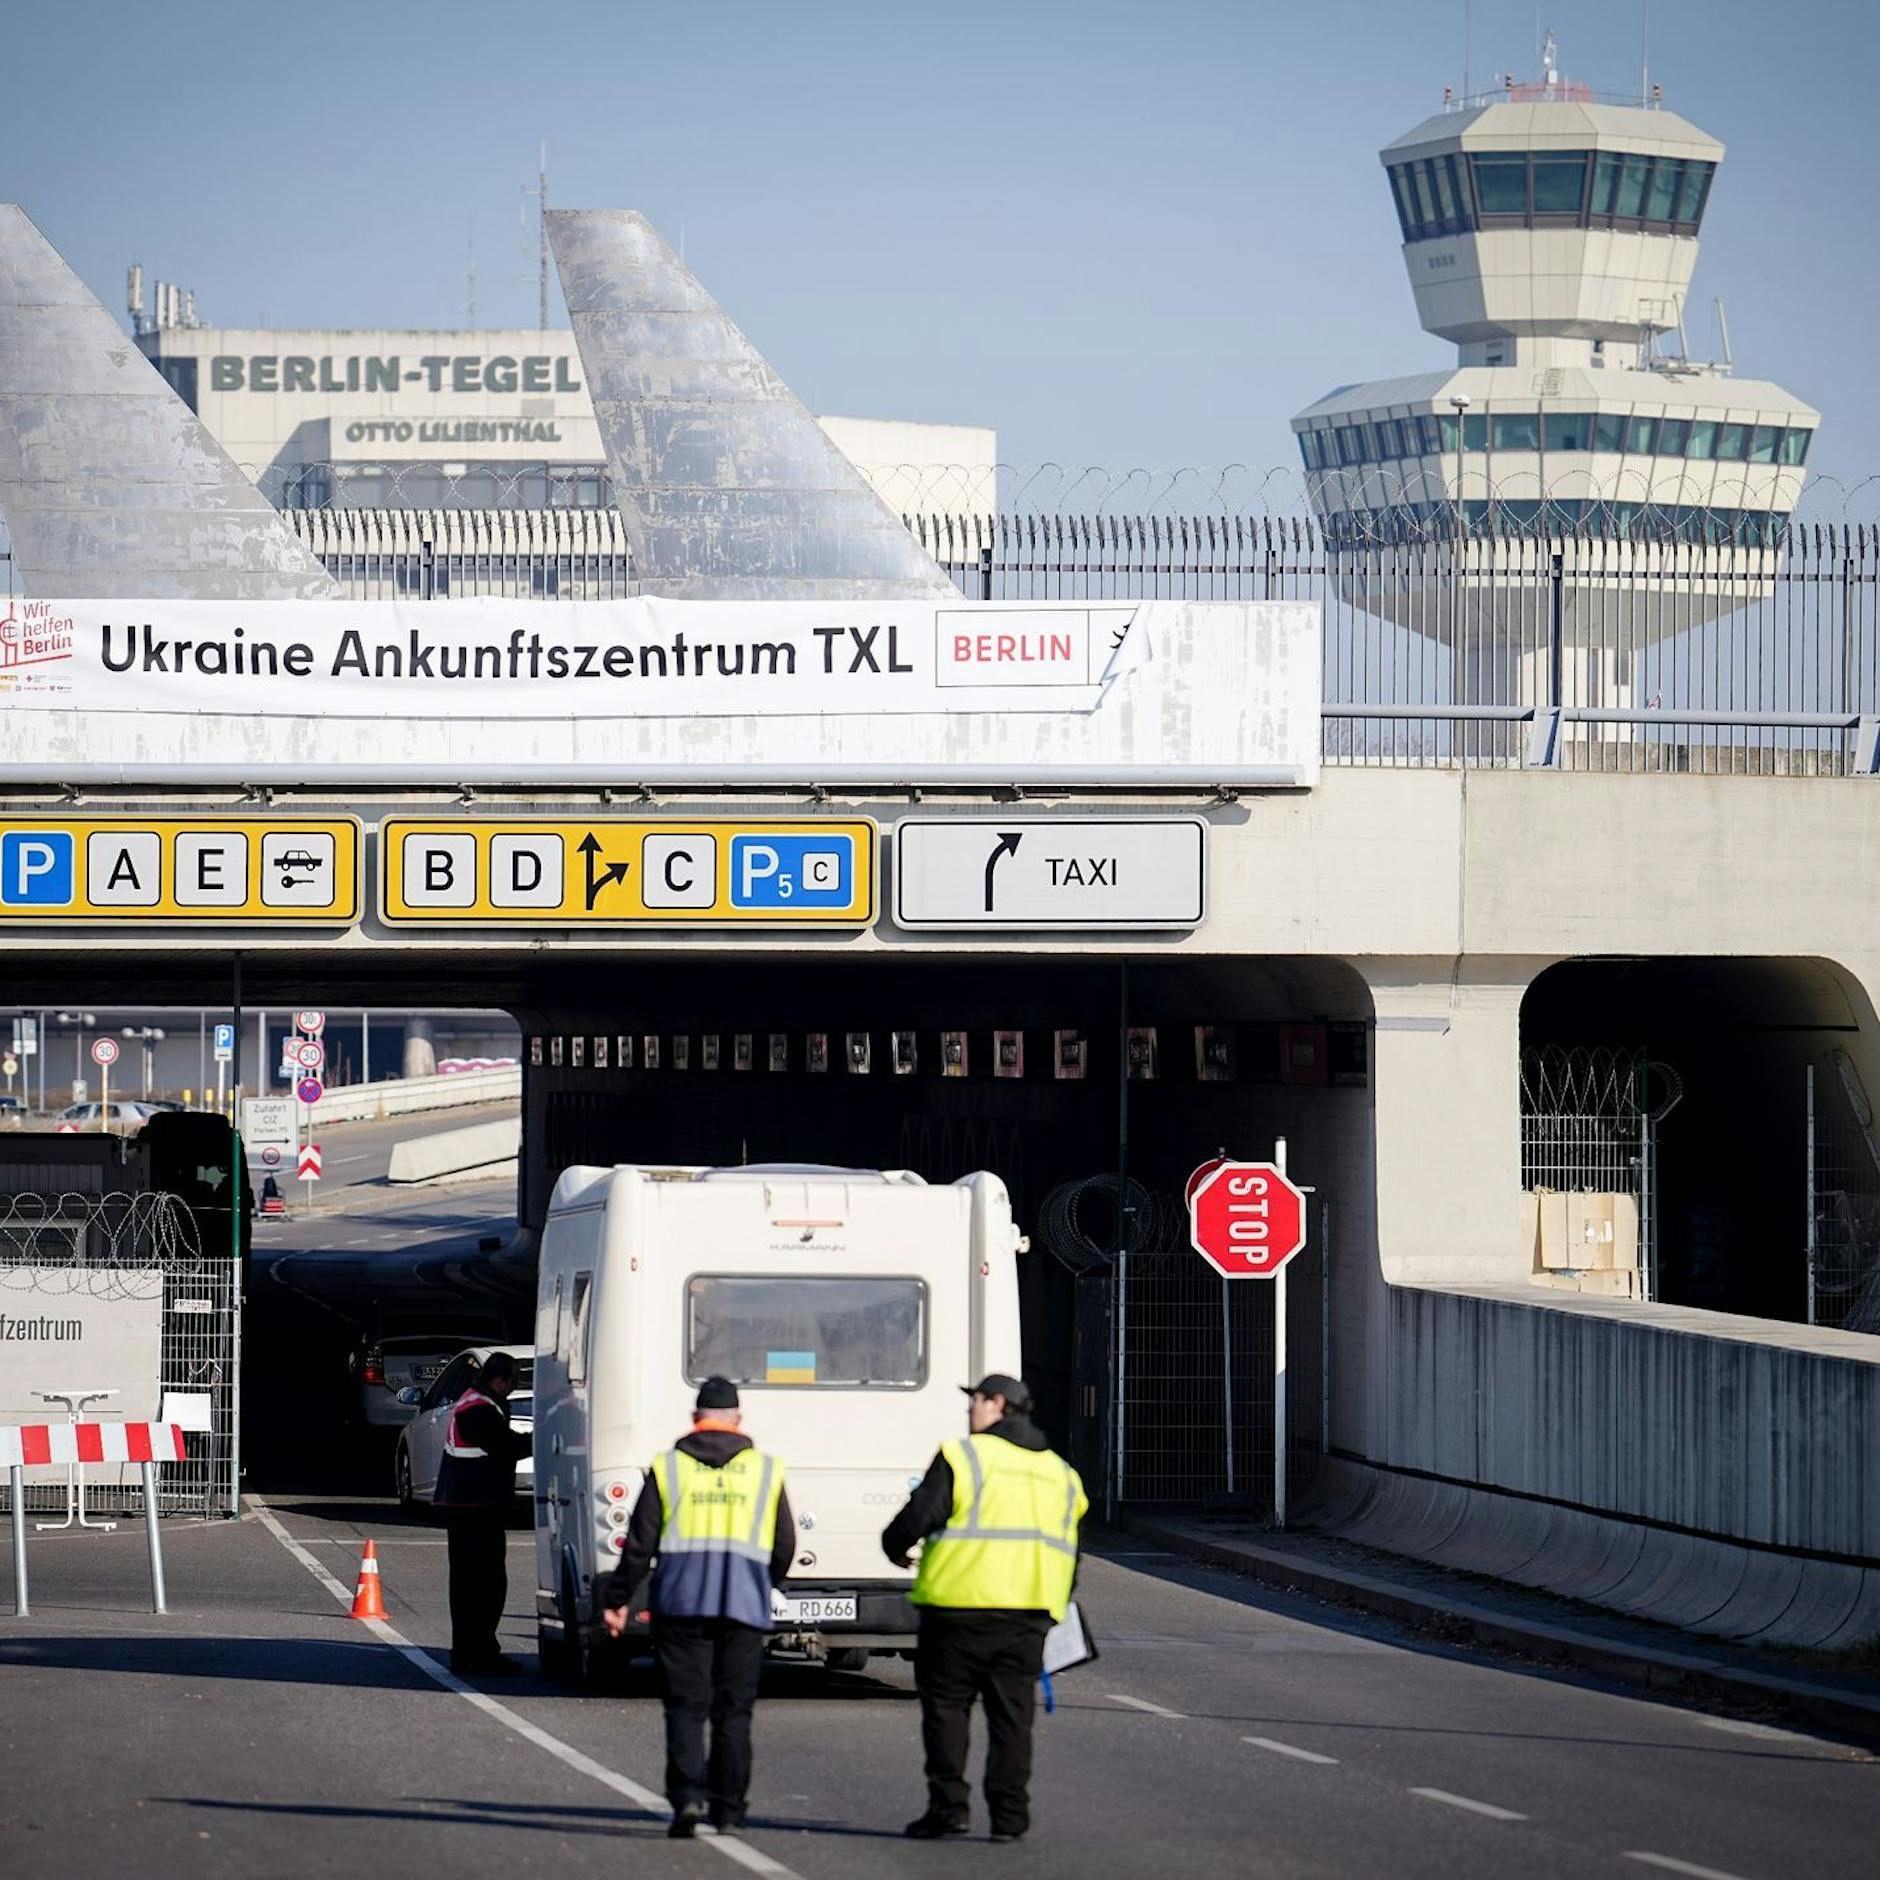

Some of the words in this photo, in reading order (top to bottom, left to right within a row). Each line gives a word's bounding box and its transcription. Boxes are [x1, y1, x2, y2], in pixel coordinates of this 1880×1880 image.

[210, 355, 582, 393] BERLIN-TEGEL
[346, 421, 413, 443] OTTO
[419, 420, 562, 443] LILIENTHAL
[24, 600, 51, 619] Wir
[24, 617, 74, 637] helfen
[24, 634, 73, 655] Berlin
[101, 625, 315, 676] Ukraine
[331, 629, 797, 679] Ankunftszentrum
[813, 625, 914, 674] TXL
[953, 634, 1072, 662] BERLIN
[18, 842, 56, 895] P
[107, 848, 141, 890] A
[198, 848, 225, 890] E
[425, 850, 455, 891] B
[511, 850, 543, 892] D
[663, 850, 694, 892] C
[812, 860, 829, 883] C
[1045, 858, 1118, 886] TAXI
[219, 1028, 230, 1047] P
[98, 1045, 113, 1057] 30
[302, 1049, 318, 1061] 30
[1227, 1176, 1269, 1265] STOP
[800, 1601, 821, 1617] RD
[824, 1601, 854, 1617] 666
